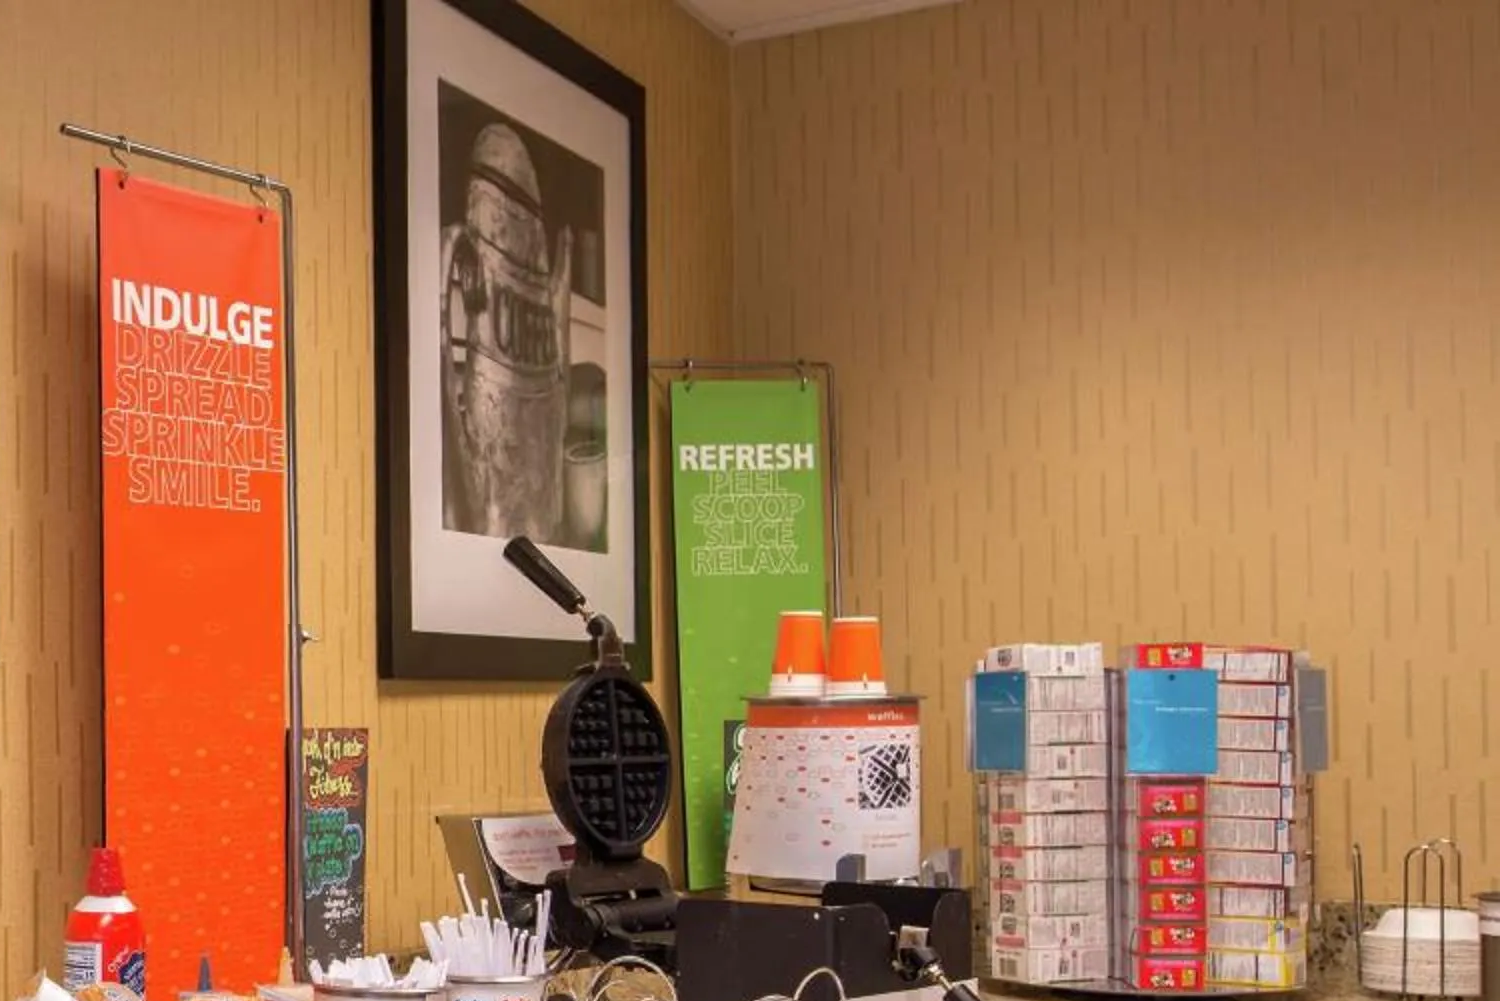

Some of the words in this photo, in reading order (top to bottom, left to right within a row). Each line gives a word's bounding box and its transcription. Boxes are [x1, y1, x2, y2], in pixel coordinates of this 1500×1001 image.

[111, 278, 274, 349] INDULGE
[115, 321, 272, 390] DRIZZLE
[115, 366, 274, 427] SPREAD
[102, 408, 286, 472] SPRINKLE
[679, 443, 815, 471] REFRESH
[129, 455, 261, 512] SMILE.
[709, 469, 788, 496] PEEL
[693, 494, 804, 524] SCOOP
[703, 519, 796, 547] SLICE
[692, 545, 810, 576] RELAX.
